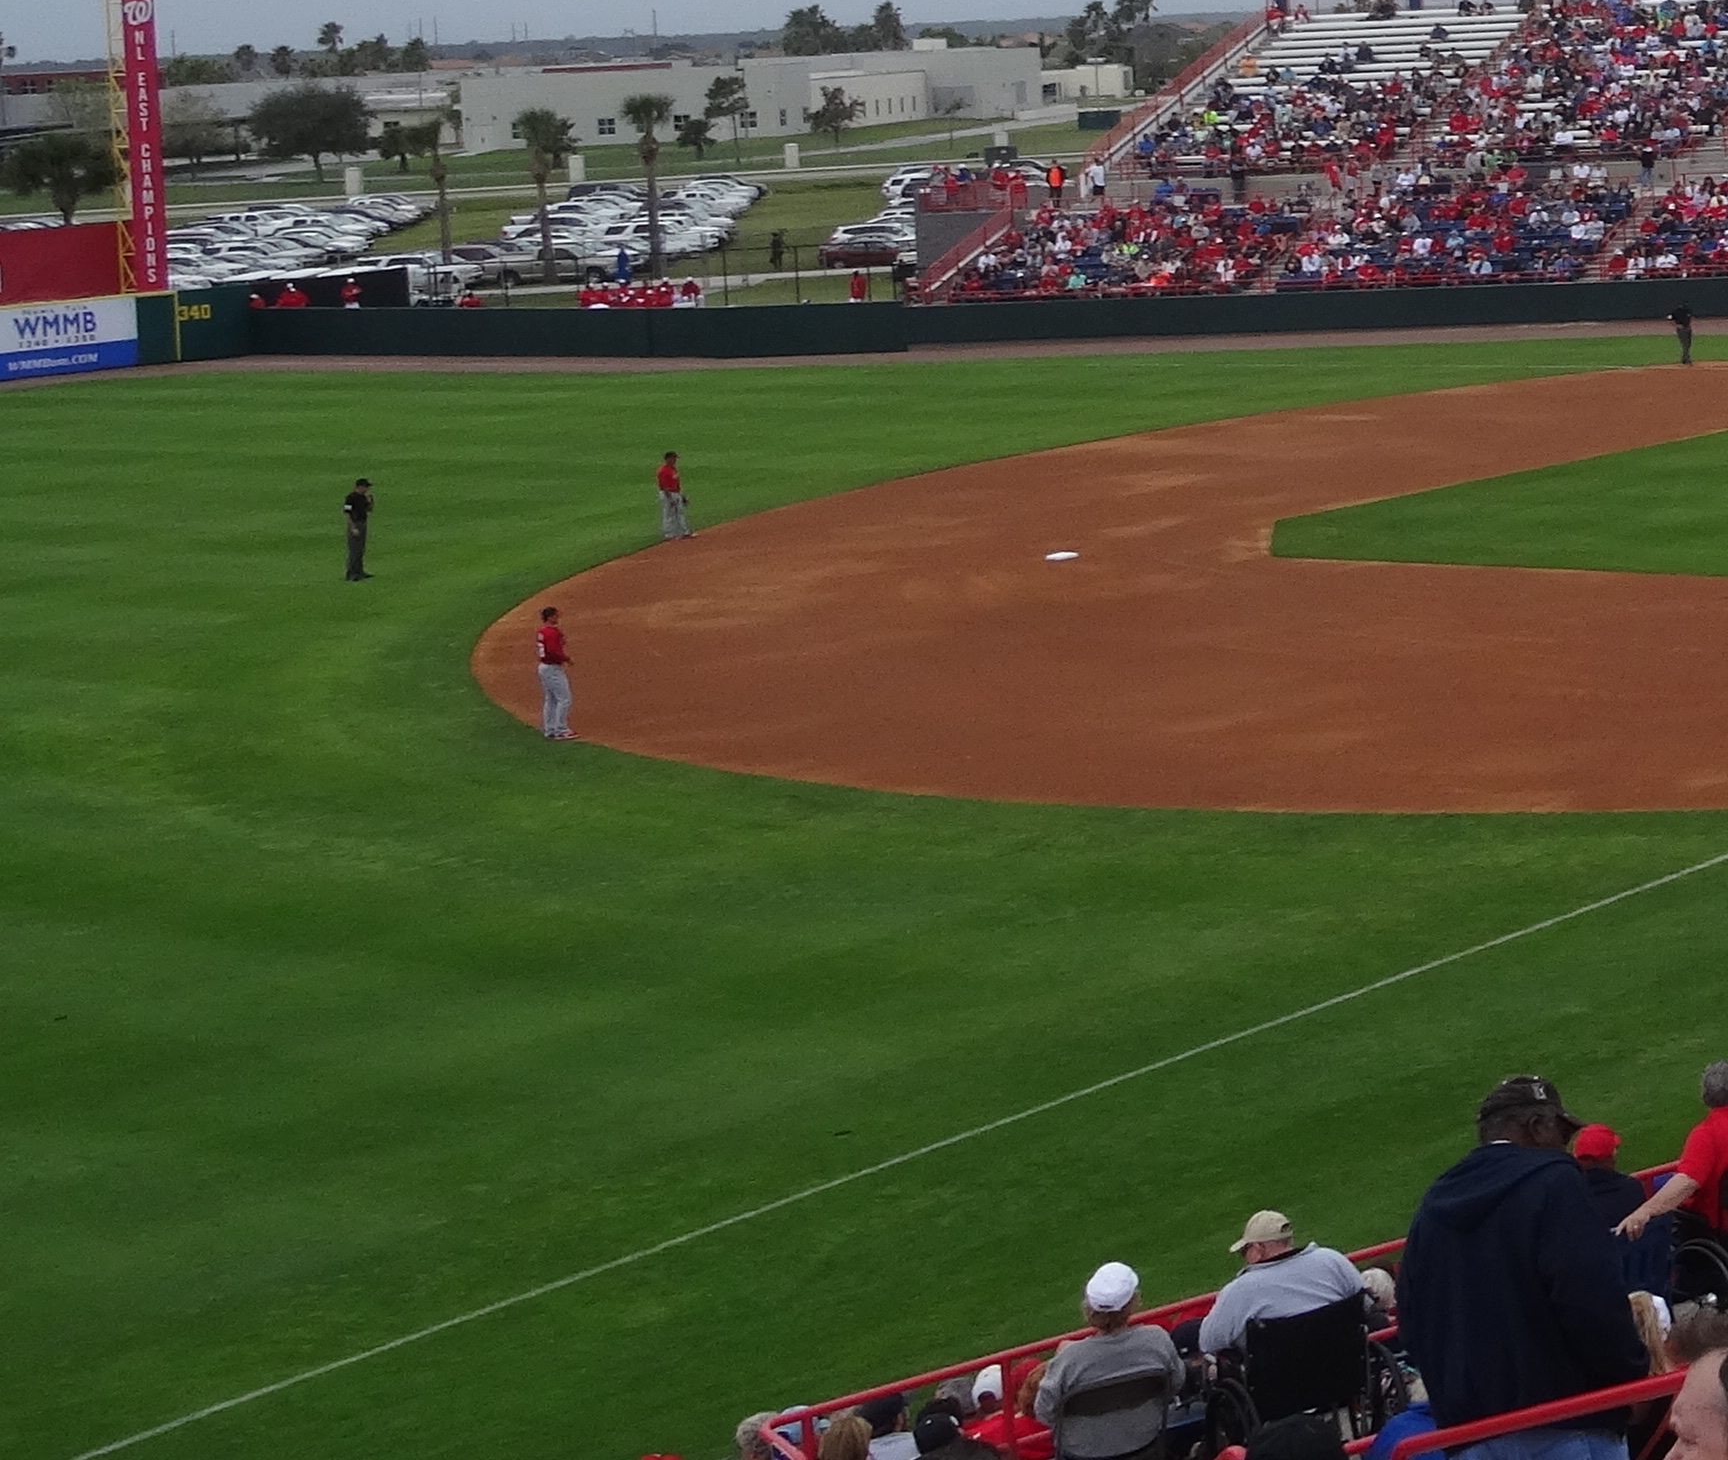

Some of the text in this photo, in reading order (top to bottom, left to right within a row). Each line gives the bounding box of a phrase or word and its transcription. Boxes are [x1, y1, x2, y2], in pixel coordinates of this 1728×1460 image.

[134, 30, 157, 283] NL EAST CHAMPIONS
[13, 311, 97, 339] WMMB
[178, 304, 211, 321] 340
